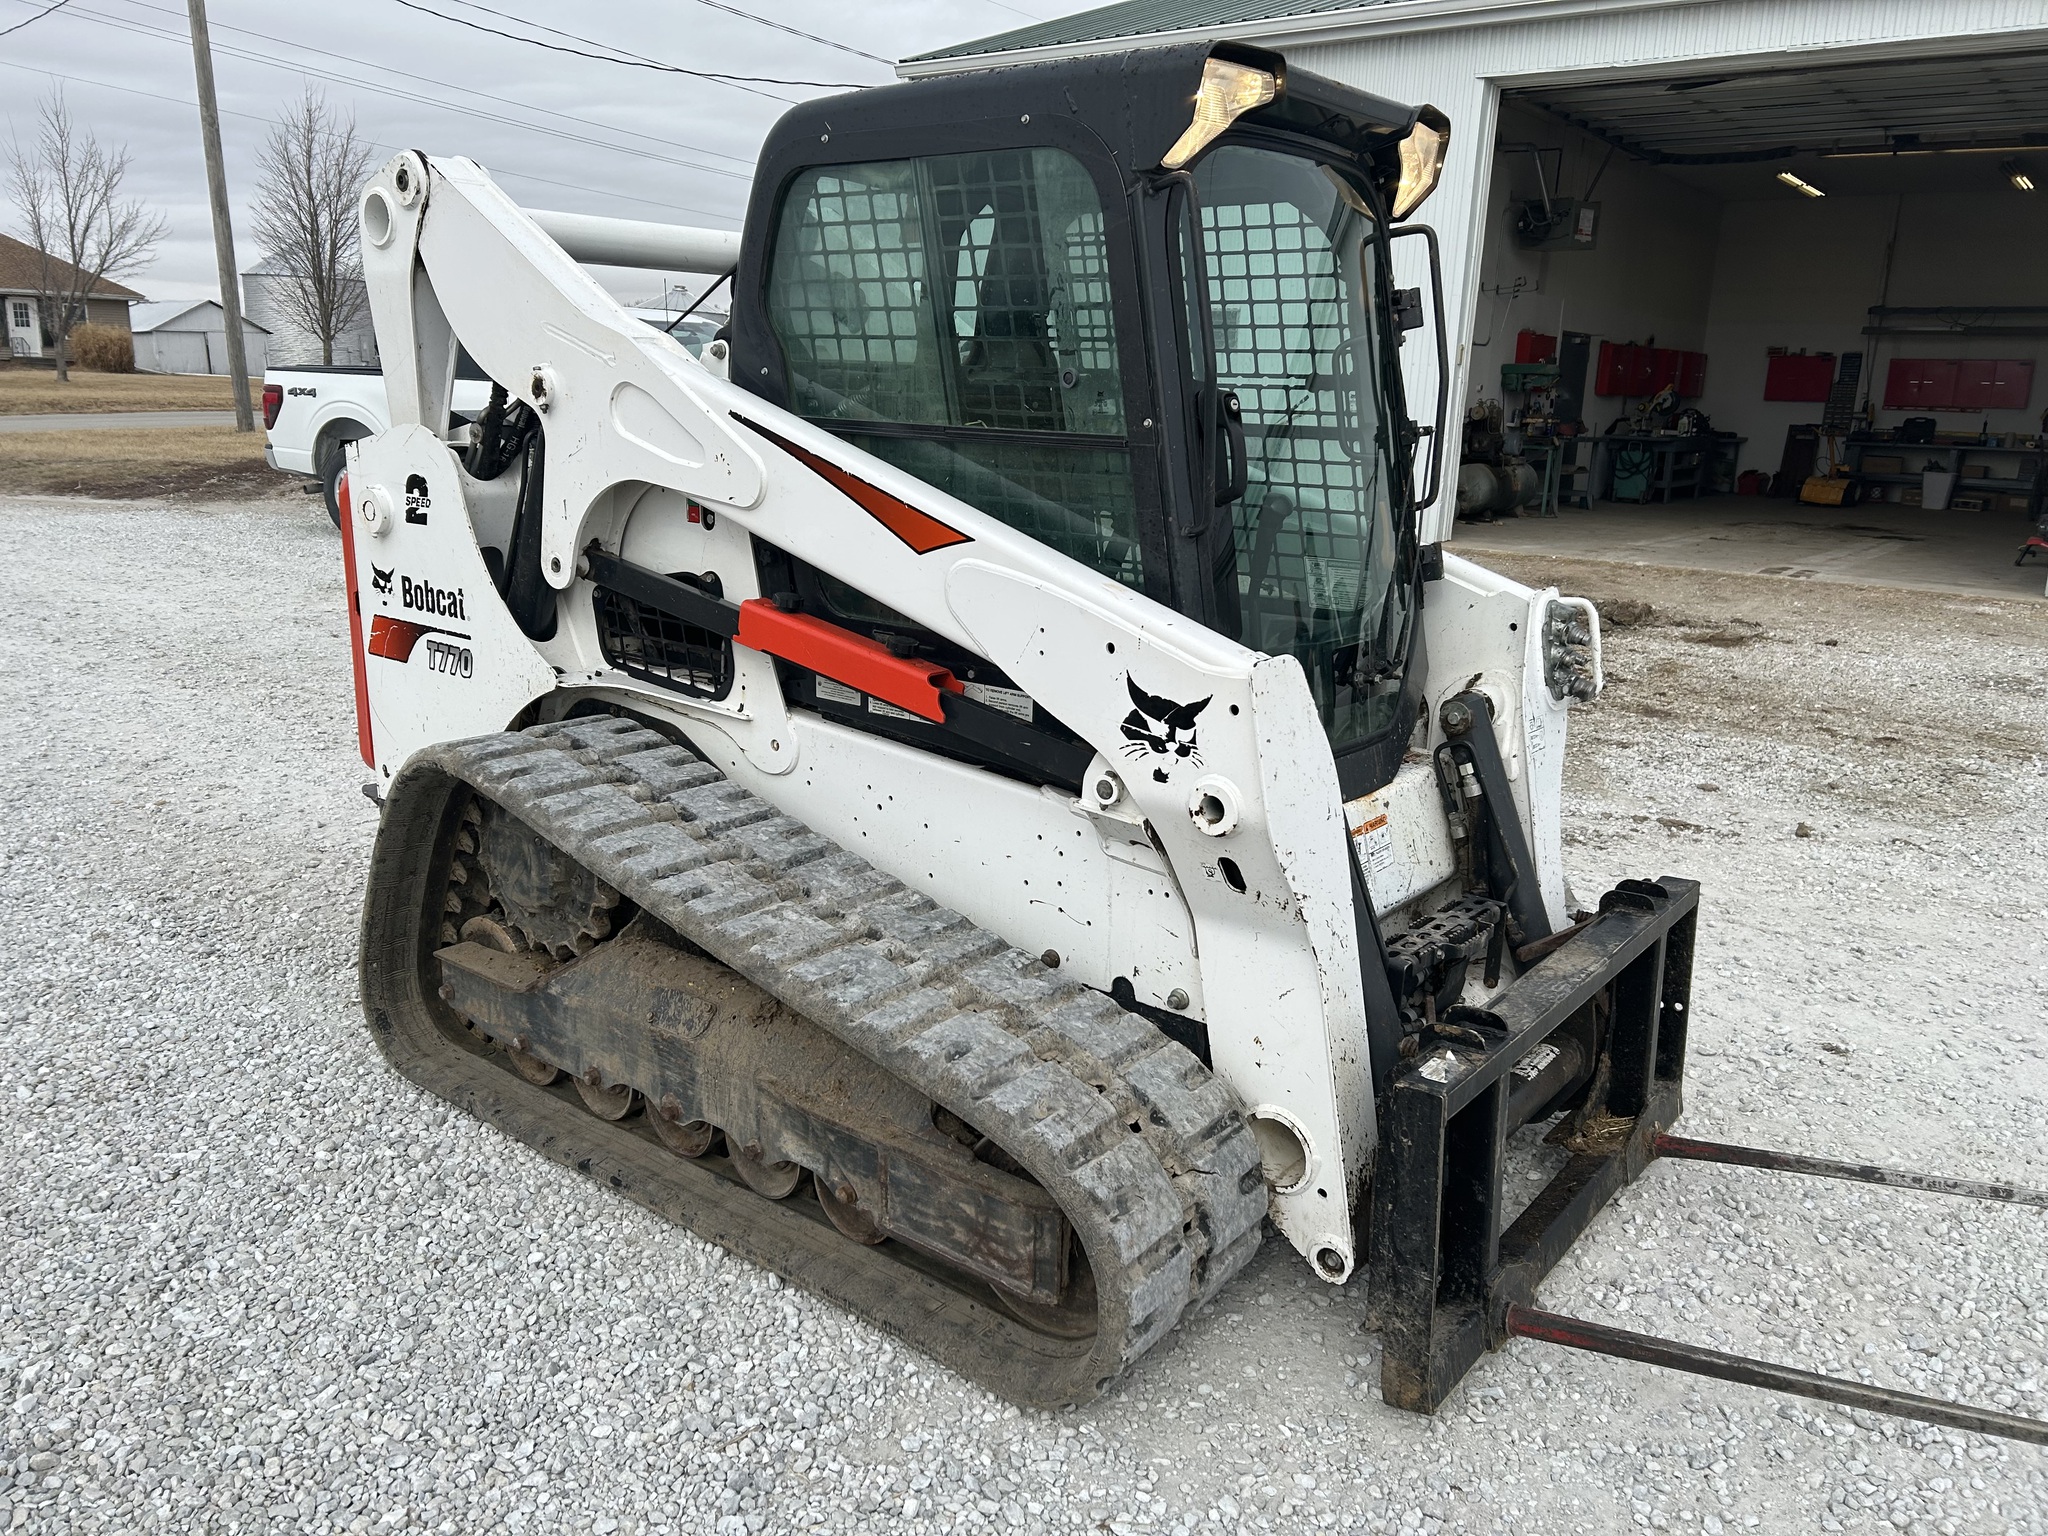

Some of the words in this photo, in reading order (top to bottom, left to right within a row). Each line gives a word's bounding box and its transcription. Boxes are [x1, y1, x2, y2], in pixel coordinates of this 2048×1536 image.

[405, 473, 429, 526] 2
[405, 495, 432, 509] SPEED
[401, 574, 466, 621] Bobcat
[426, 639, 473, 679] T770
